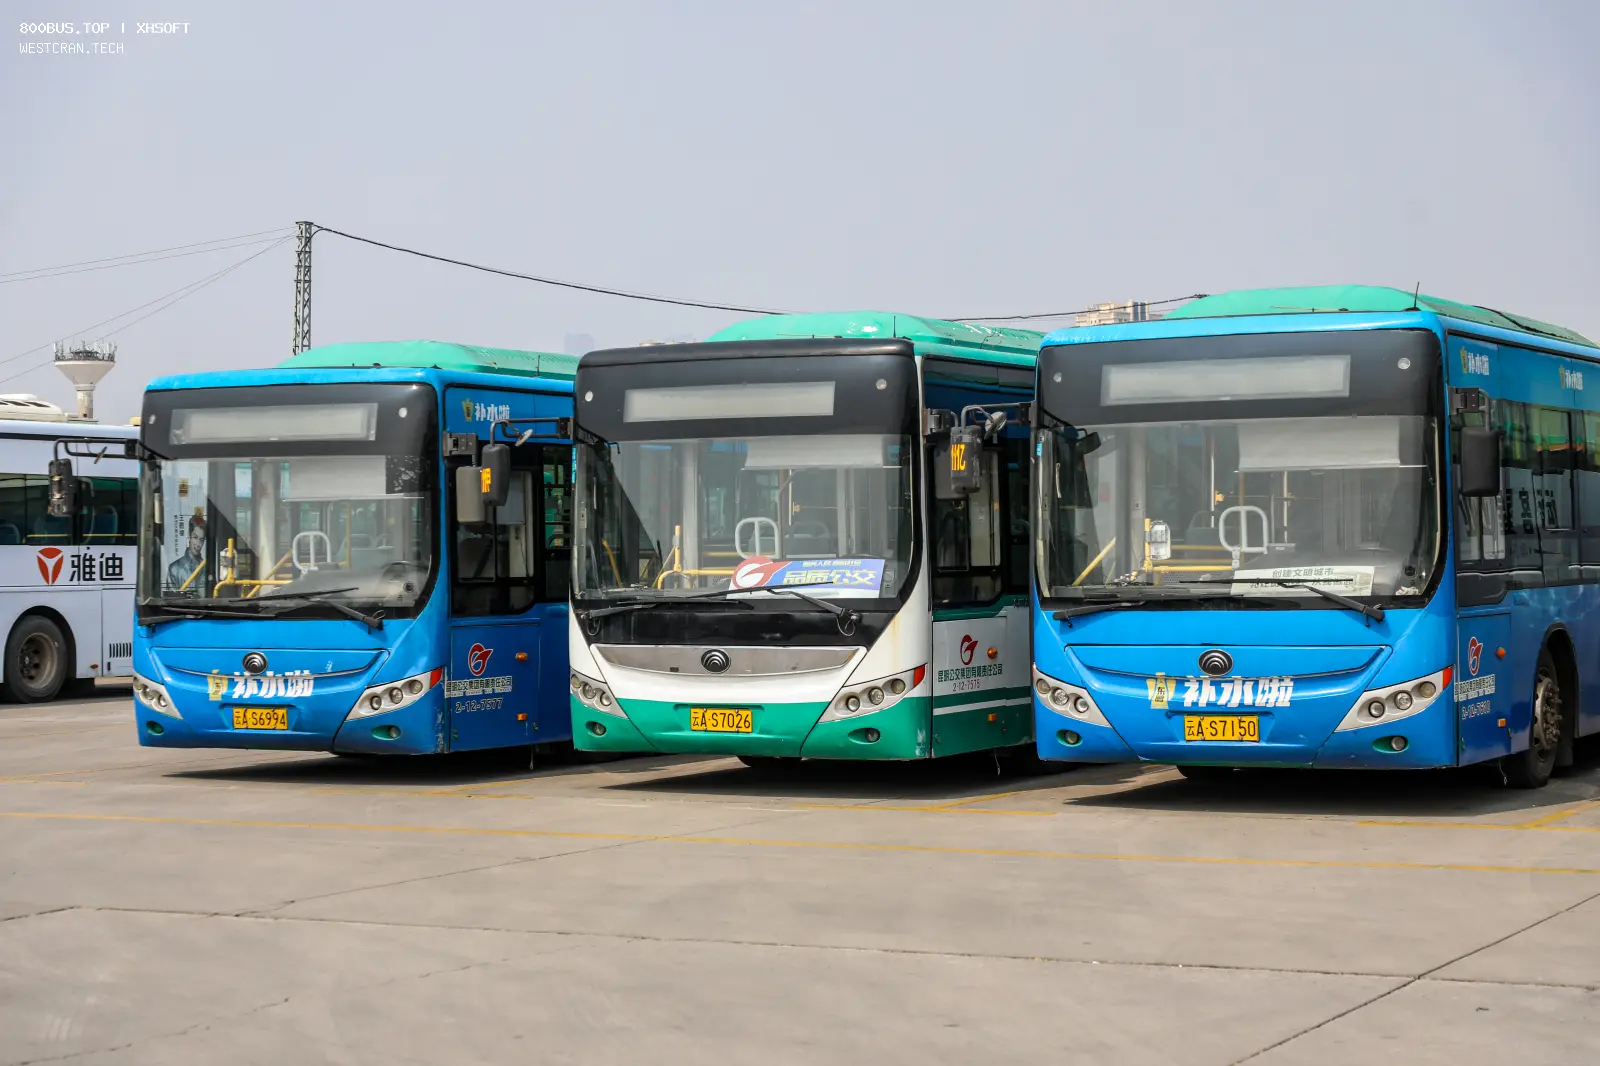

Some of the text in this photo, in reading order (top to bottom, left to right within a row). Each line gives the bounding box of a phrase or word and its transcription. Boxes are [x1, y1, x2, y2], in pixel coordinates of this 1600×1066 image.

[474, 402, 510, 422] 补水啦
[69, 552, 124, 582] 雅迪
[1272, 567, 1334, 579] 创建文明城市
[783, 569, 878, 586] 品质公交
[937, 663, 1003, 683] 昆明公交集团有限责任公司
[231, 670, 314, 699] 补水啦
[1182, 675, 1294, 708] 补水啦
